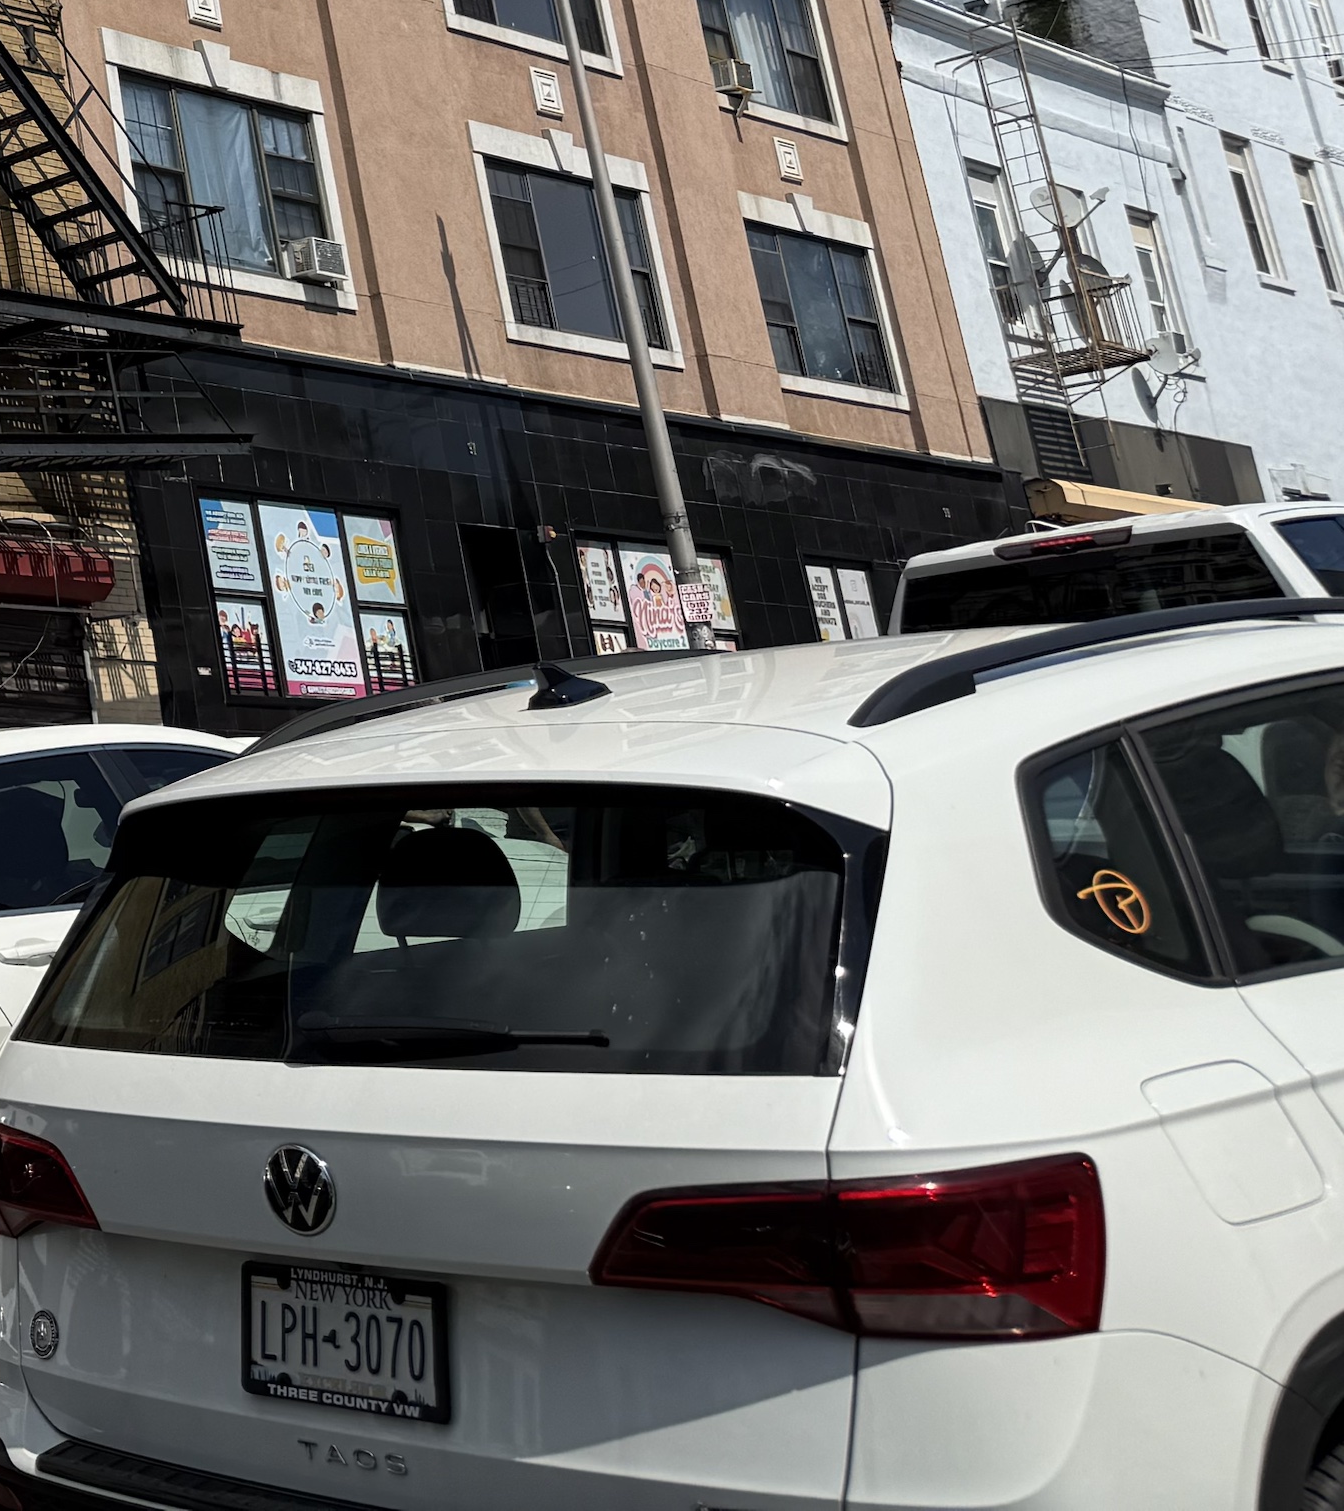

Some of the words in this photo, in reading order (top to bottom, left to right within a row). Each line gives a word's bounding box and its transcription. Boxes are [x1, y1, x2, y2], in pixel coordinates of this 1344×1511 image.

[682, 593, 710, 602] CARS
[647, 638, 680, 649] Daycare
[365, 1277, 388, 1289] N.J.
[293, 1281, 343, 1304] NEW
[343, 1285, 392, 1311] YORK
[267, 1383, 318, 1402] THREE
[322, 1392, 388, 1413] COUNTY
[392, 1403, 420, 1418] VW
[297, 1439, 408, 1476] TAOS
